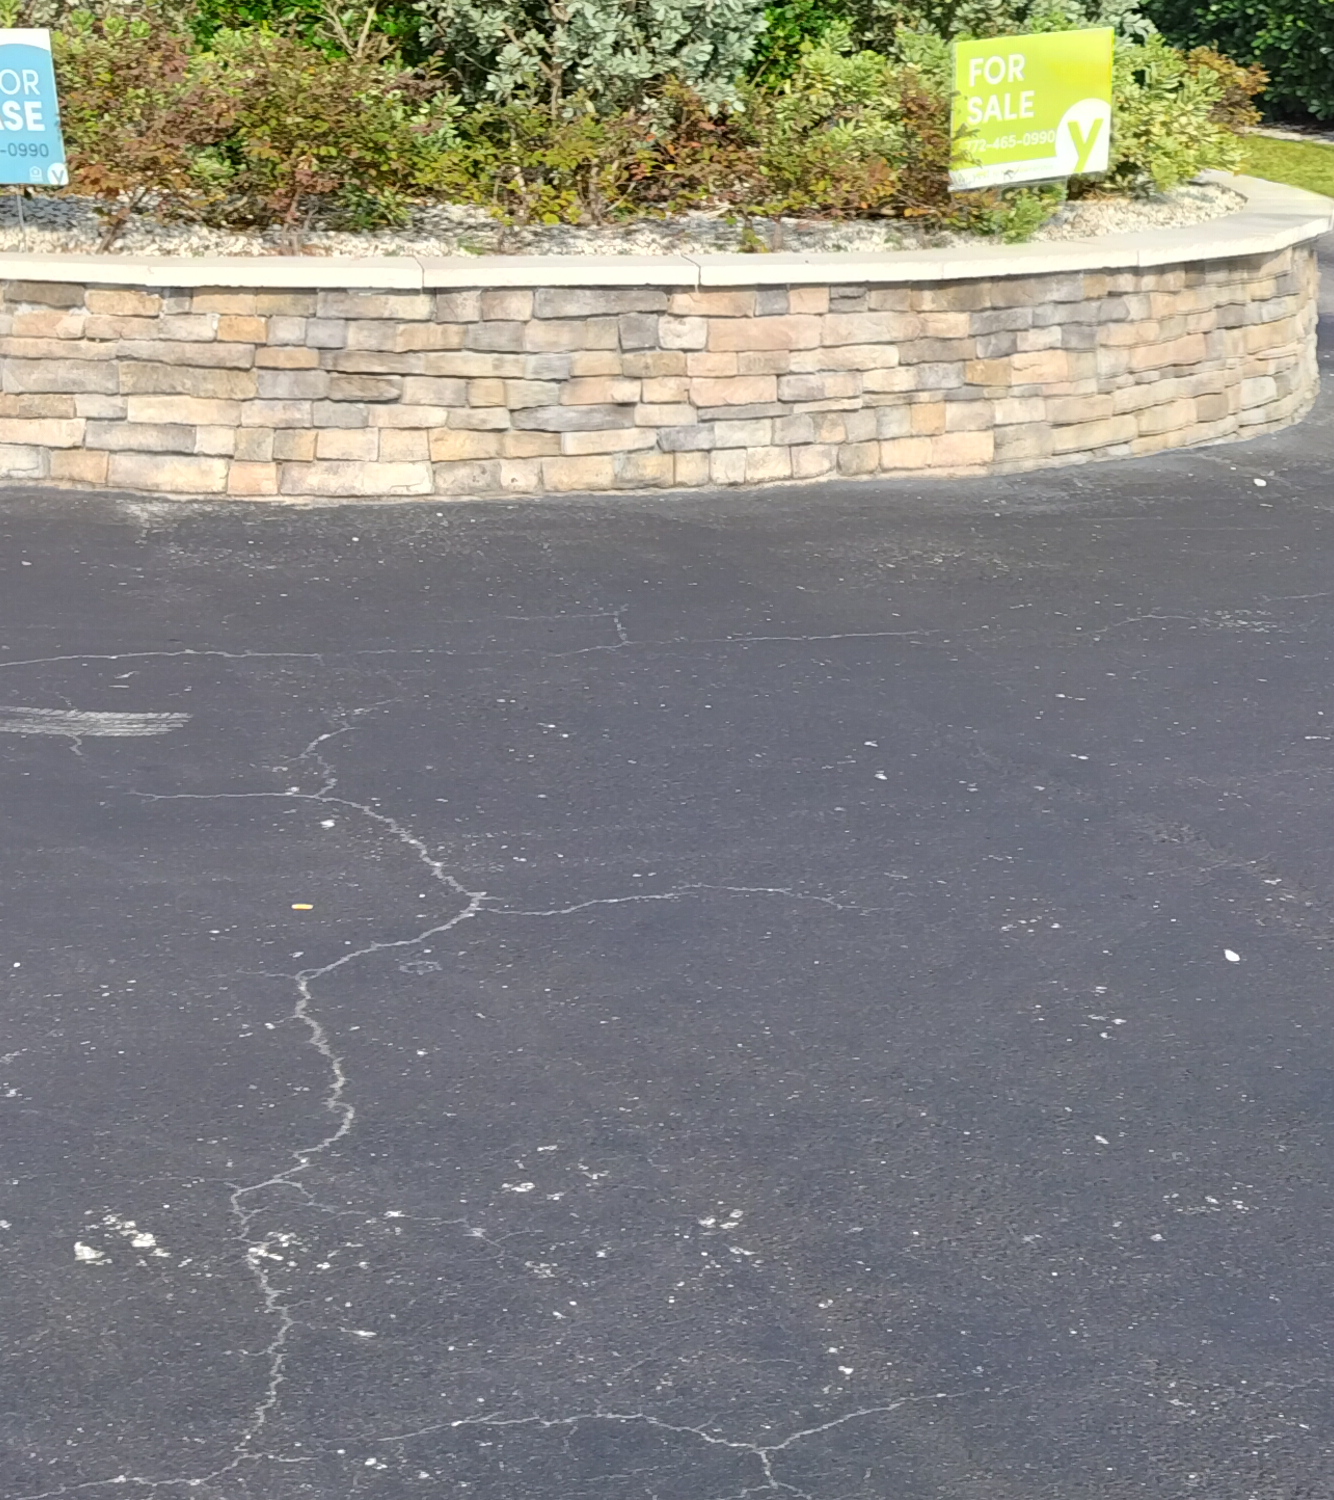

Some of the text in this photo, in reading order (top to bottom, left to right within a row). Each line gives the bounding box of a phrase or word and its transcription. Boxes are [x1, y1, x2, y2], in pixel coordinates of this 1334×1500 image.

[968, 53, 1025, 87] FOR
[966, 90, 1035, 126] SALE
[964, 129, 1056, 155] 772-465-0990
